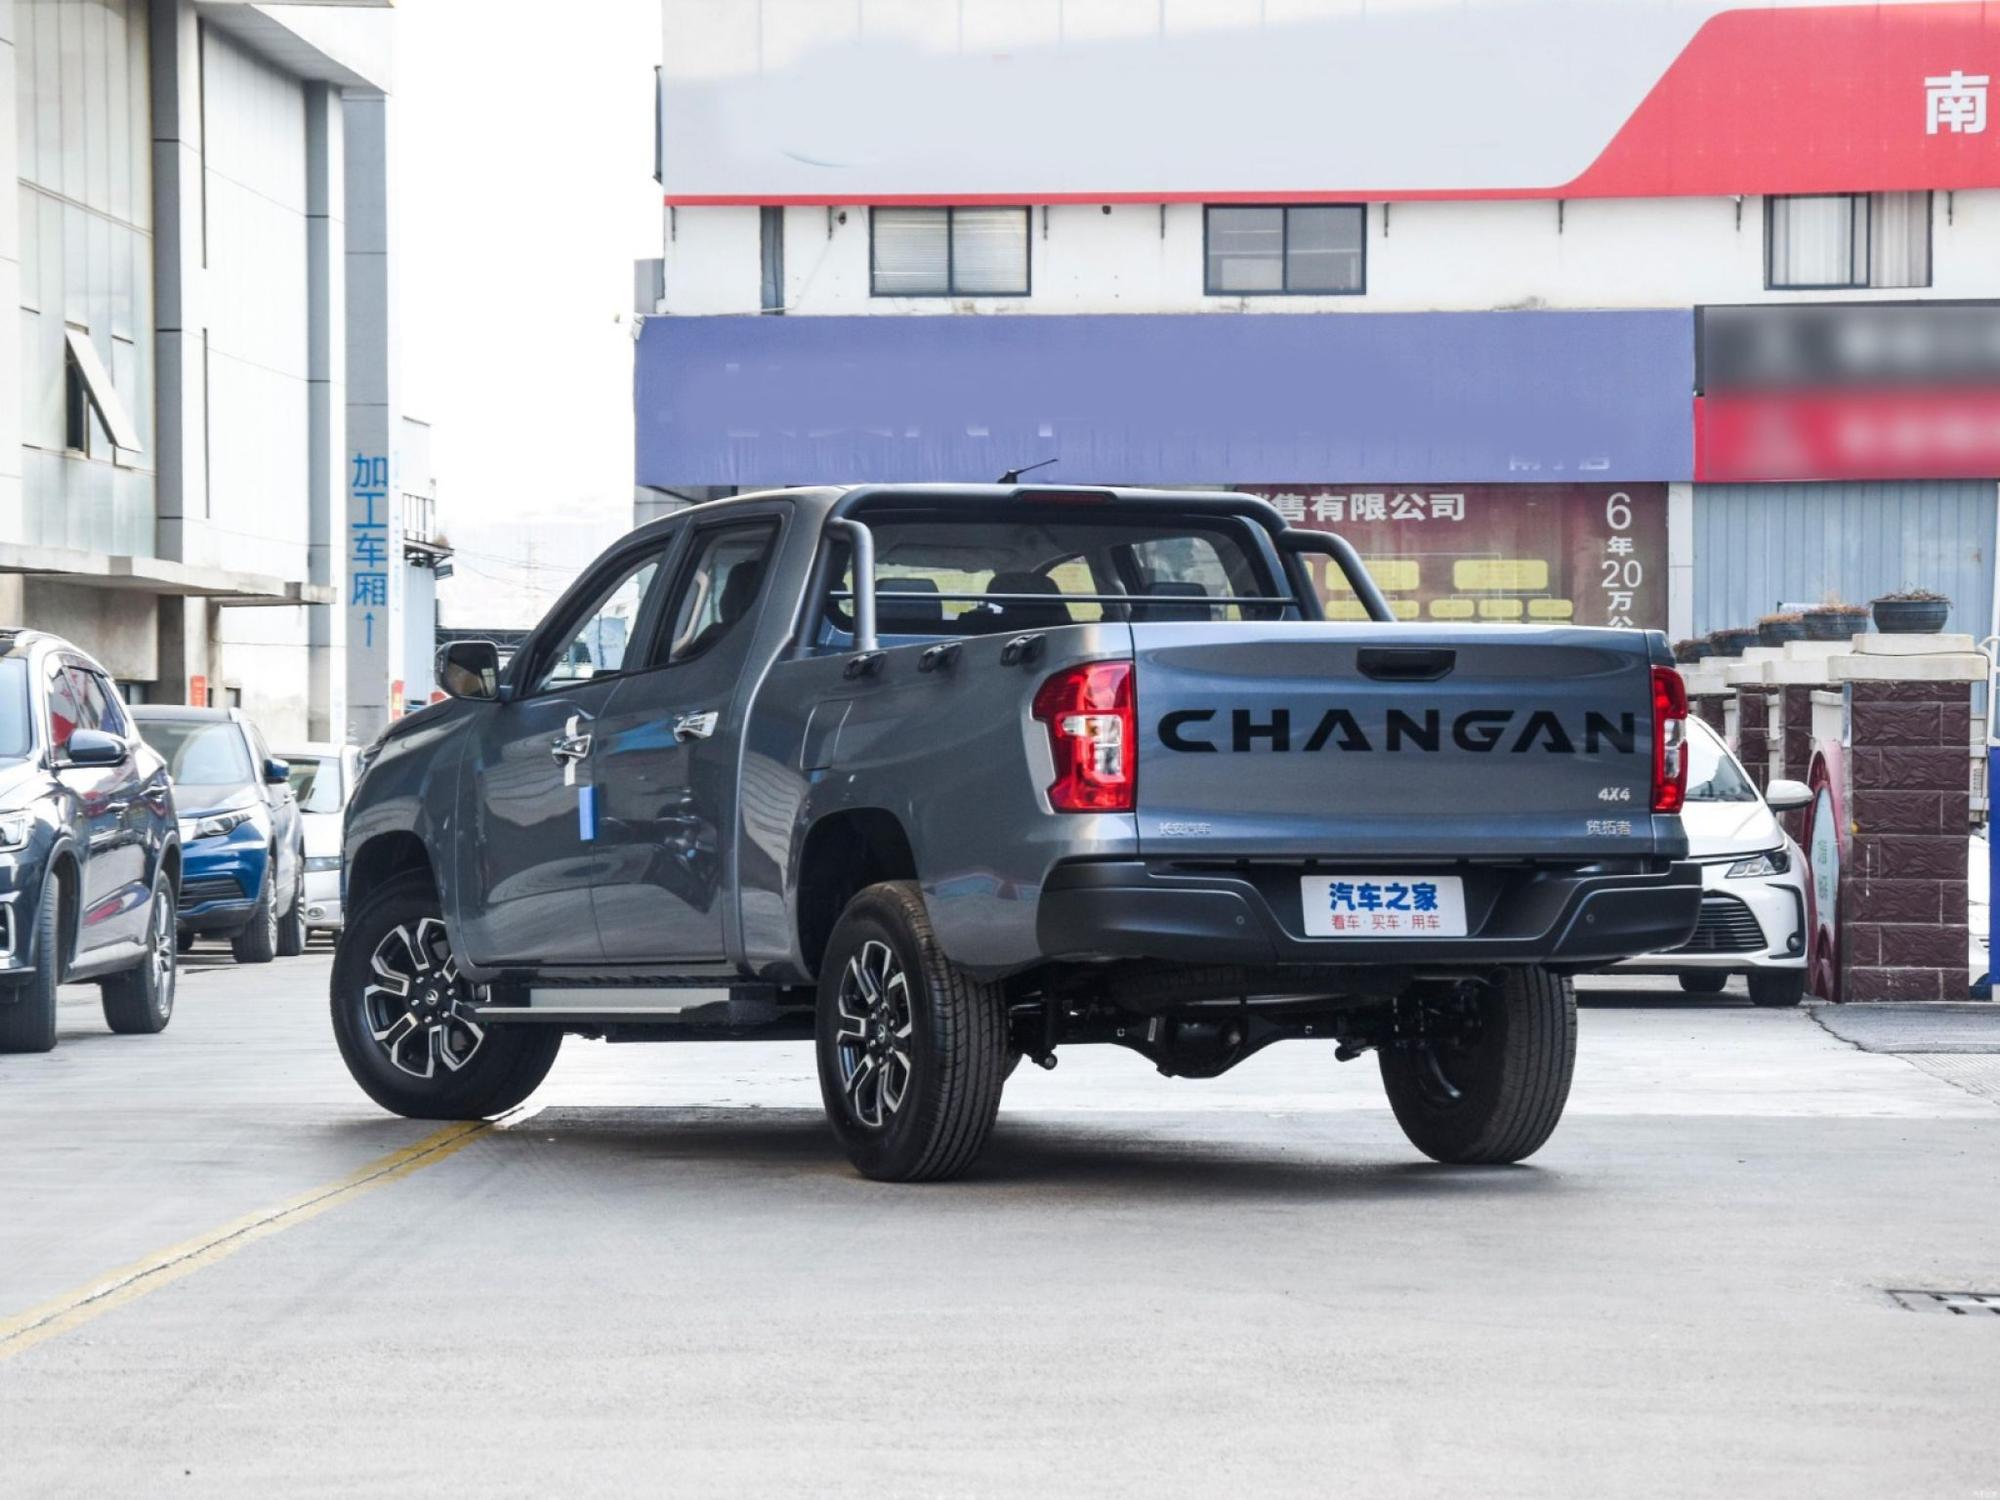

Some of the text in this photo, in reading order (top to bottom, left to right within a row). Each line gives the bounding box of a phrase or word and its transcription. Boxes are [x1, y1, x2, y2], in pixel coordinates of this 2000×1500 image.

[1924, 70, 1990, 135] 南
[352, 453, 388, 607] 加工车厢
[1157, 708, 1635, 754] CHANGAN
[1329, 882, 1439, 911] 汽车之家
